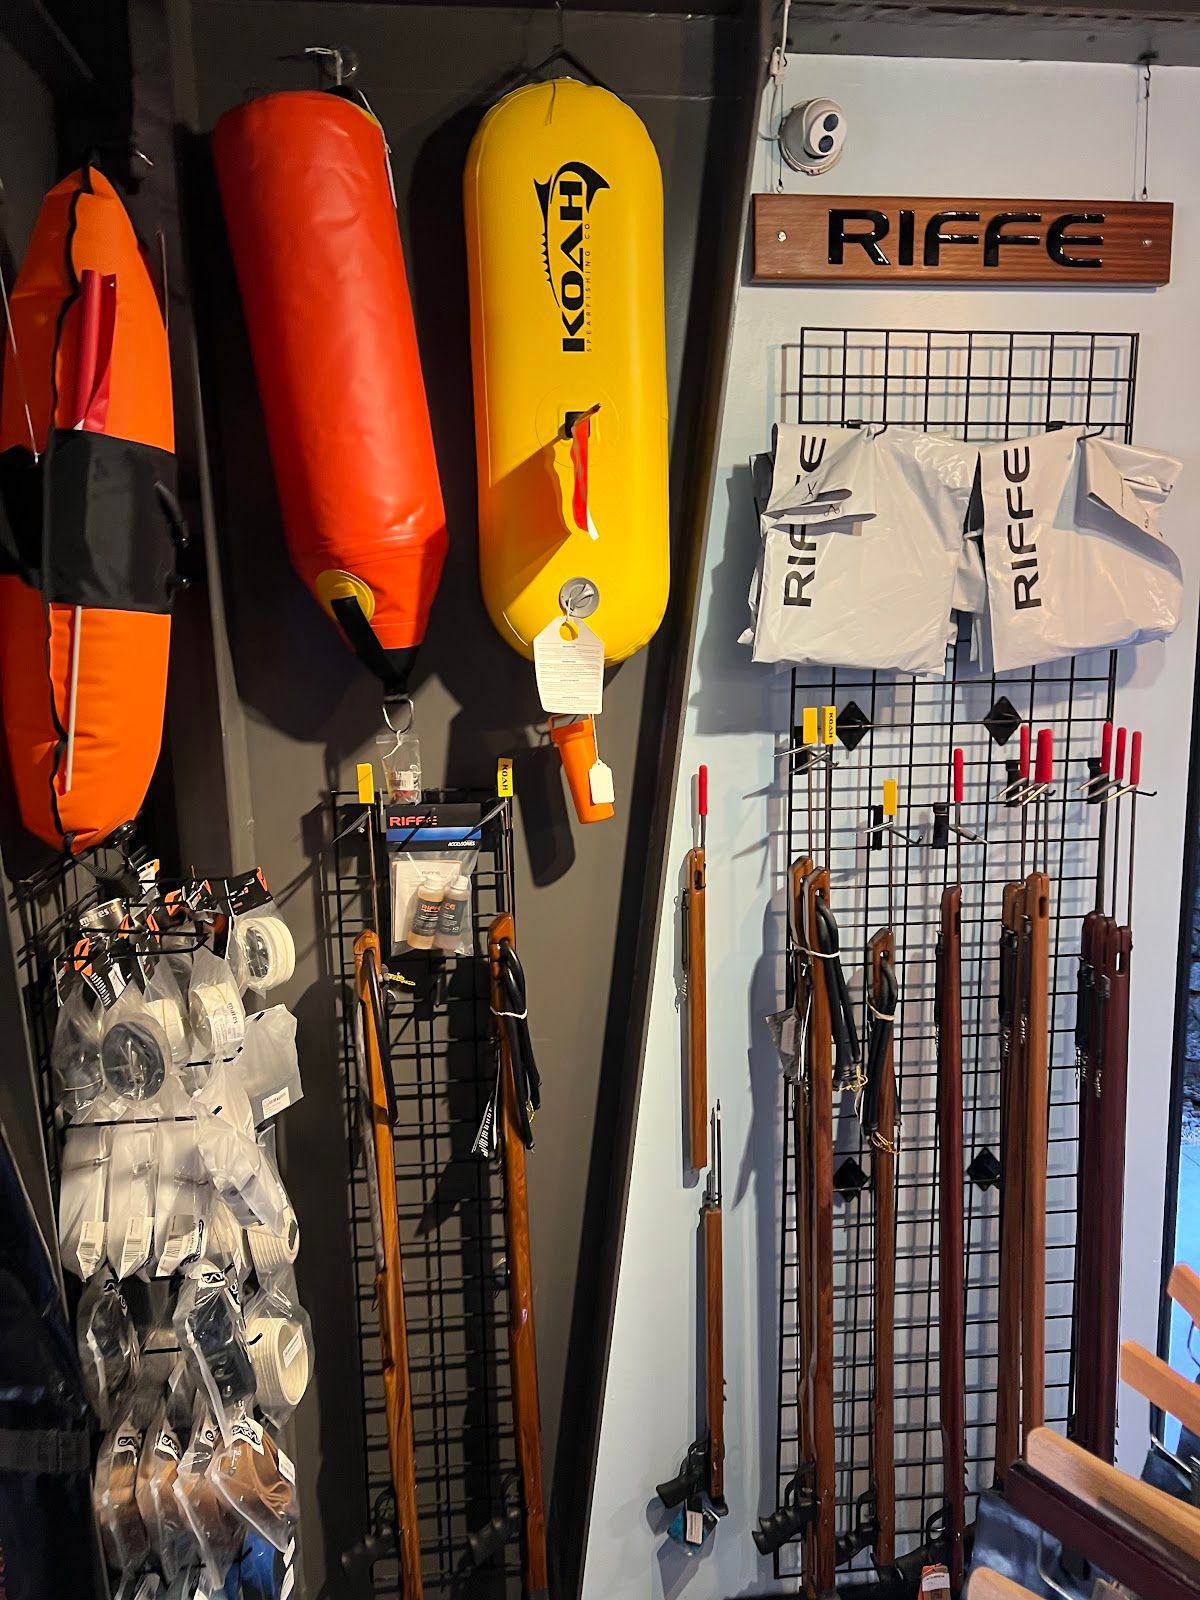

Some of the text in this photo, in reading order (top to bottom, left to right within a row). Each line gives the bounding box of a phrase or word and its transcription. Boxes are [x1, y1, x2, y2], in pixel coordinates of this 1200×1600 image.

[559, 180, 585, 352] KOAH
[828, 208, 1106, 268] RIFFE
[783, 434, 827, 607] RIFE
[1003, 446, 1042, 610] RIFFE
[79, 908, 110, 927] mares
[226, 1002, 239, 1025] mares
